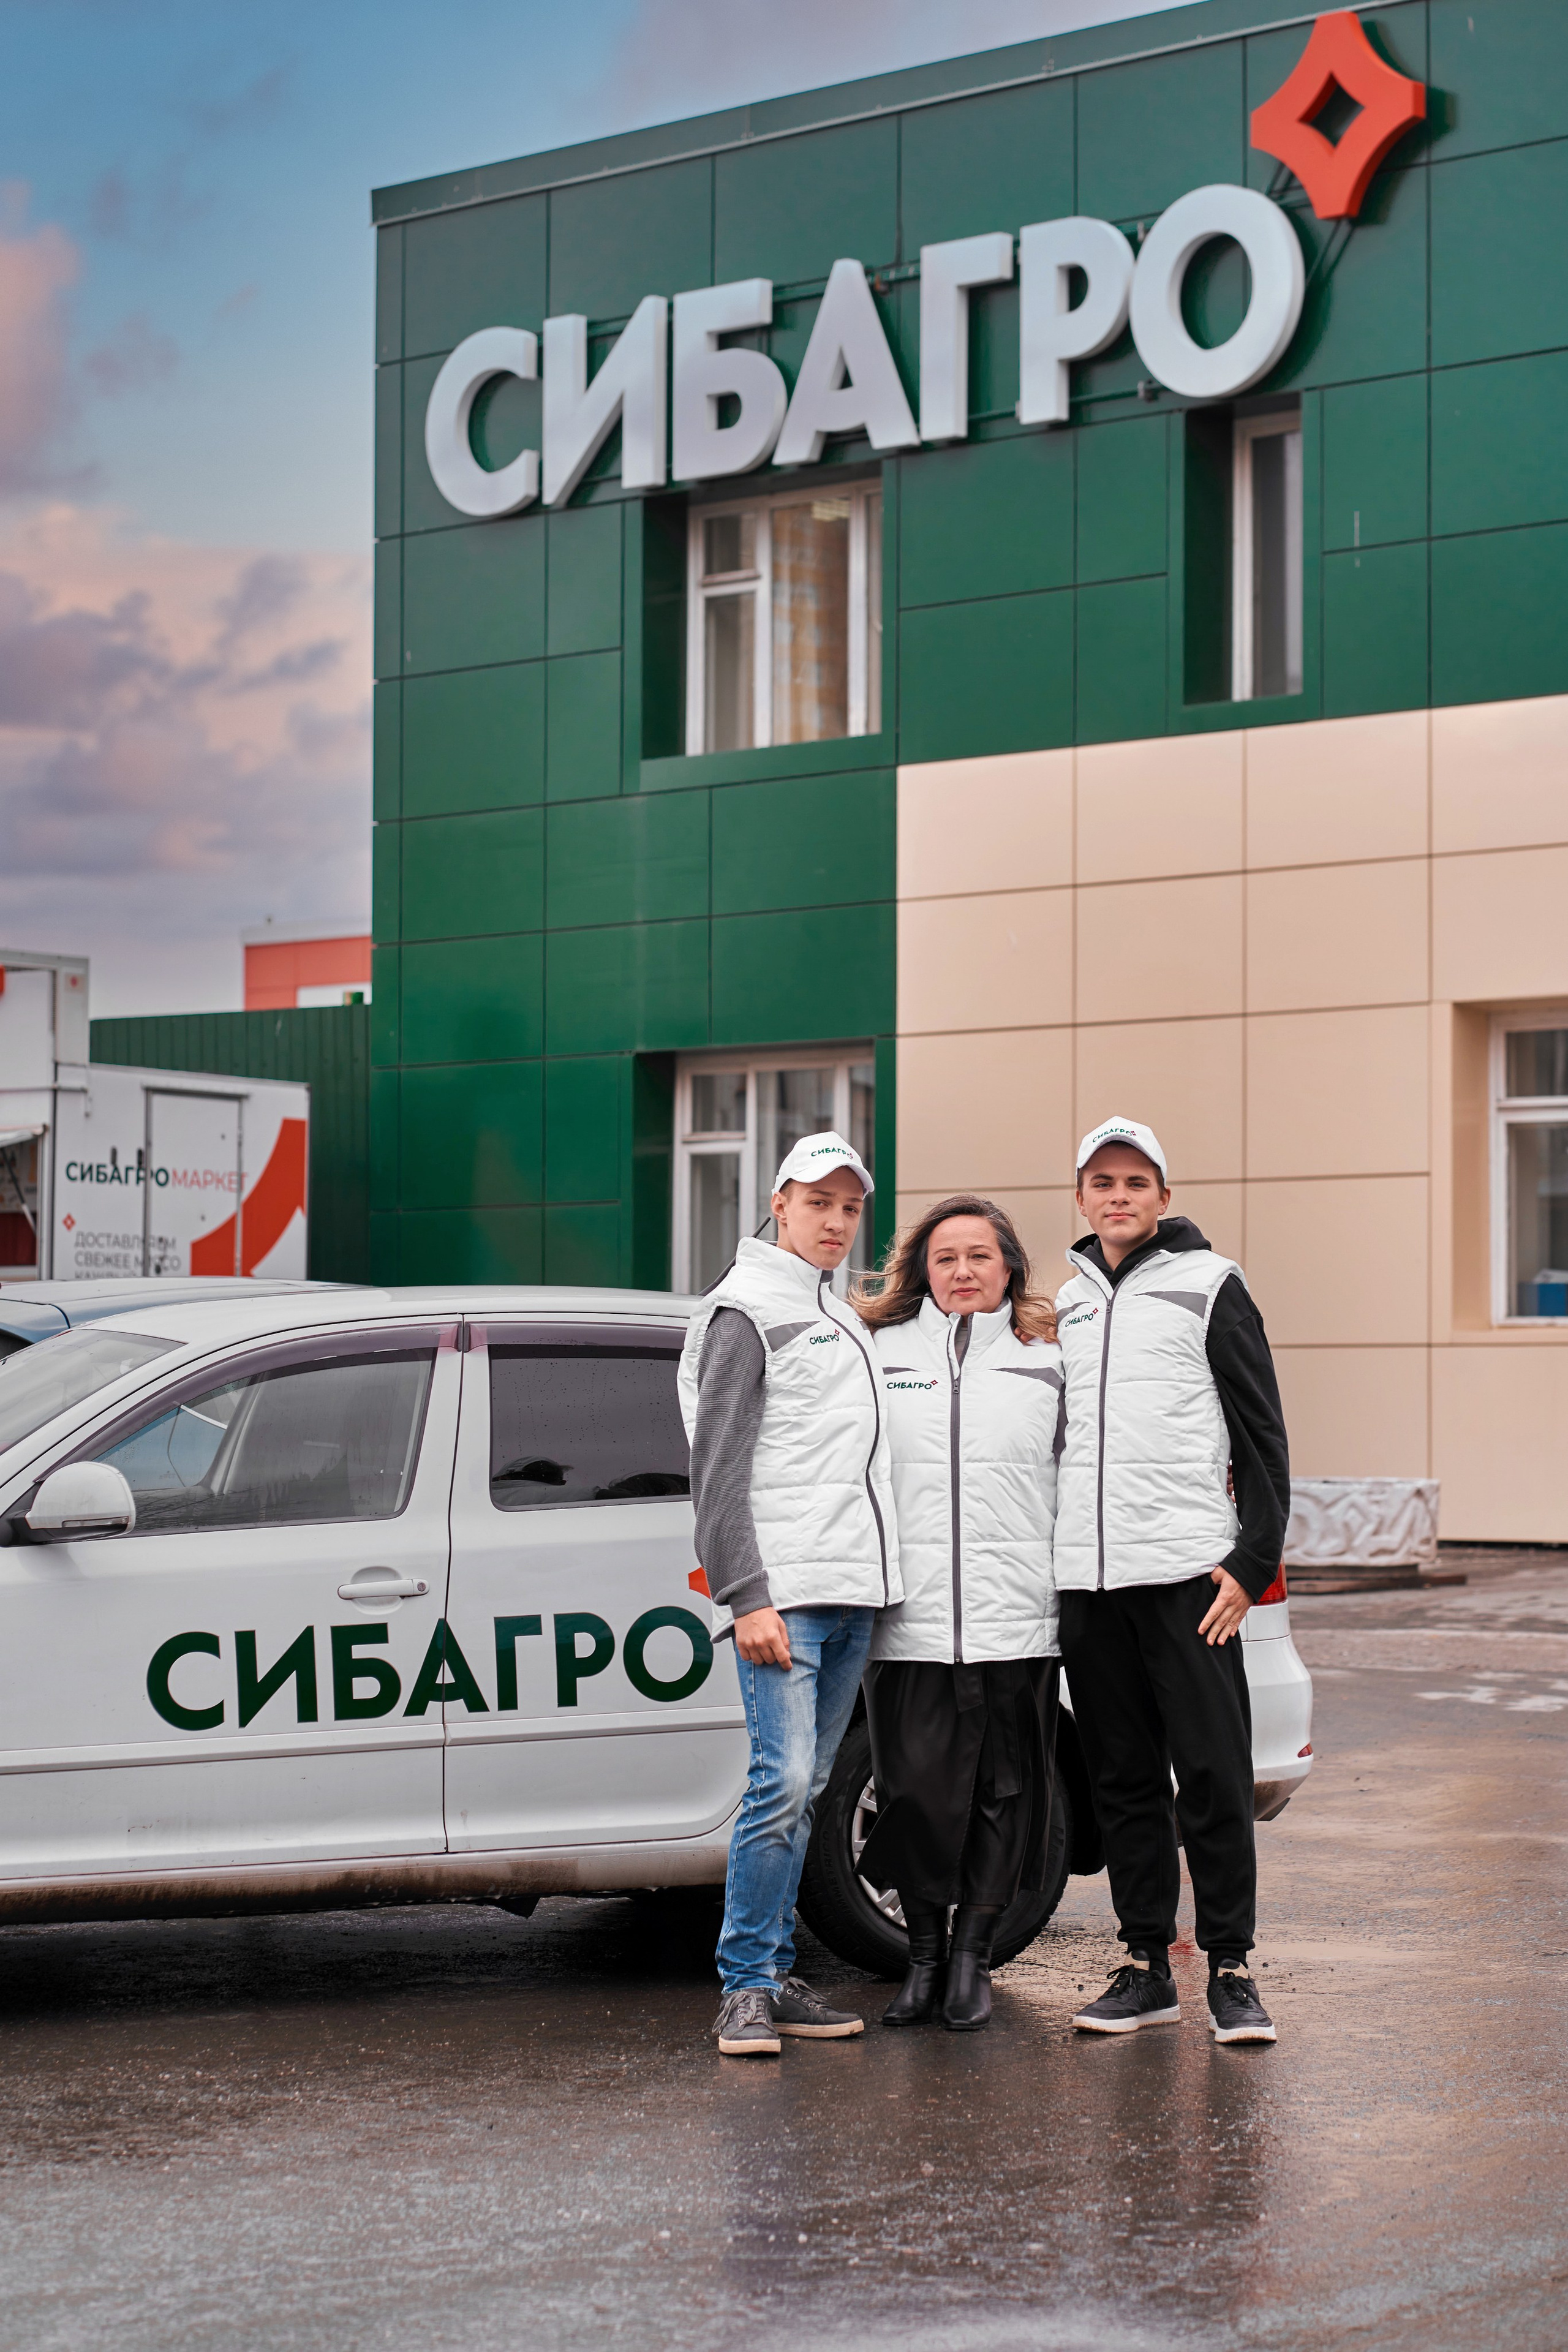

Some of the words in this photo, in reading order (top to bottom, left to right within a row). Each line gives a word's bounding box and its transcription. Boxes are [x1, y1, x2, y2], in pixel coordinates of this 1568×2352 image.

[426, 184, 1306, 518] СИБАГРО
[1093, 1128, 1132, 1143] СИБАГРО
[811, 1147, 852, 1159] СИБАГРО
[74, 1250, 132, 1270] СВЕЖЕЕ
[1065, 1313, 1094, 1327] СИБАГРО
[809, 1334, 839, 1345] СИБАГРО
[146, 1606, 714, 1732] СИБАГРО
